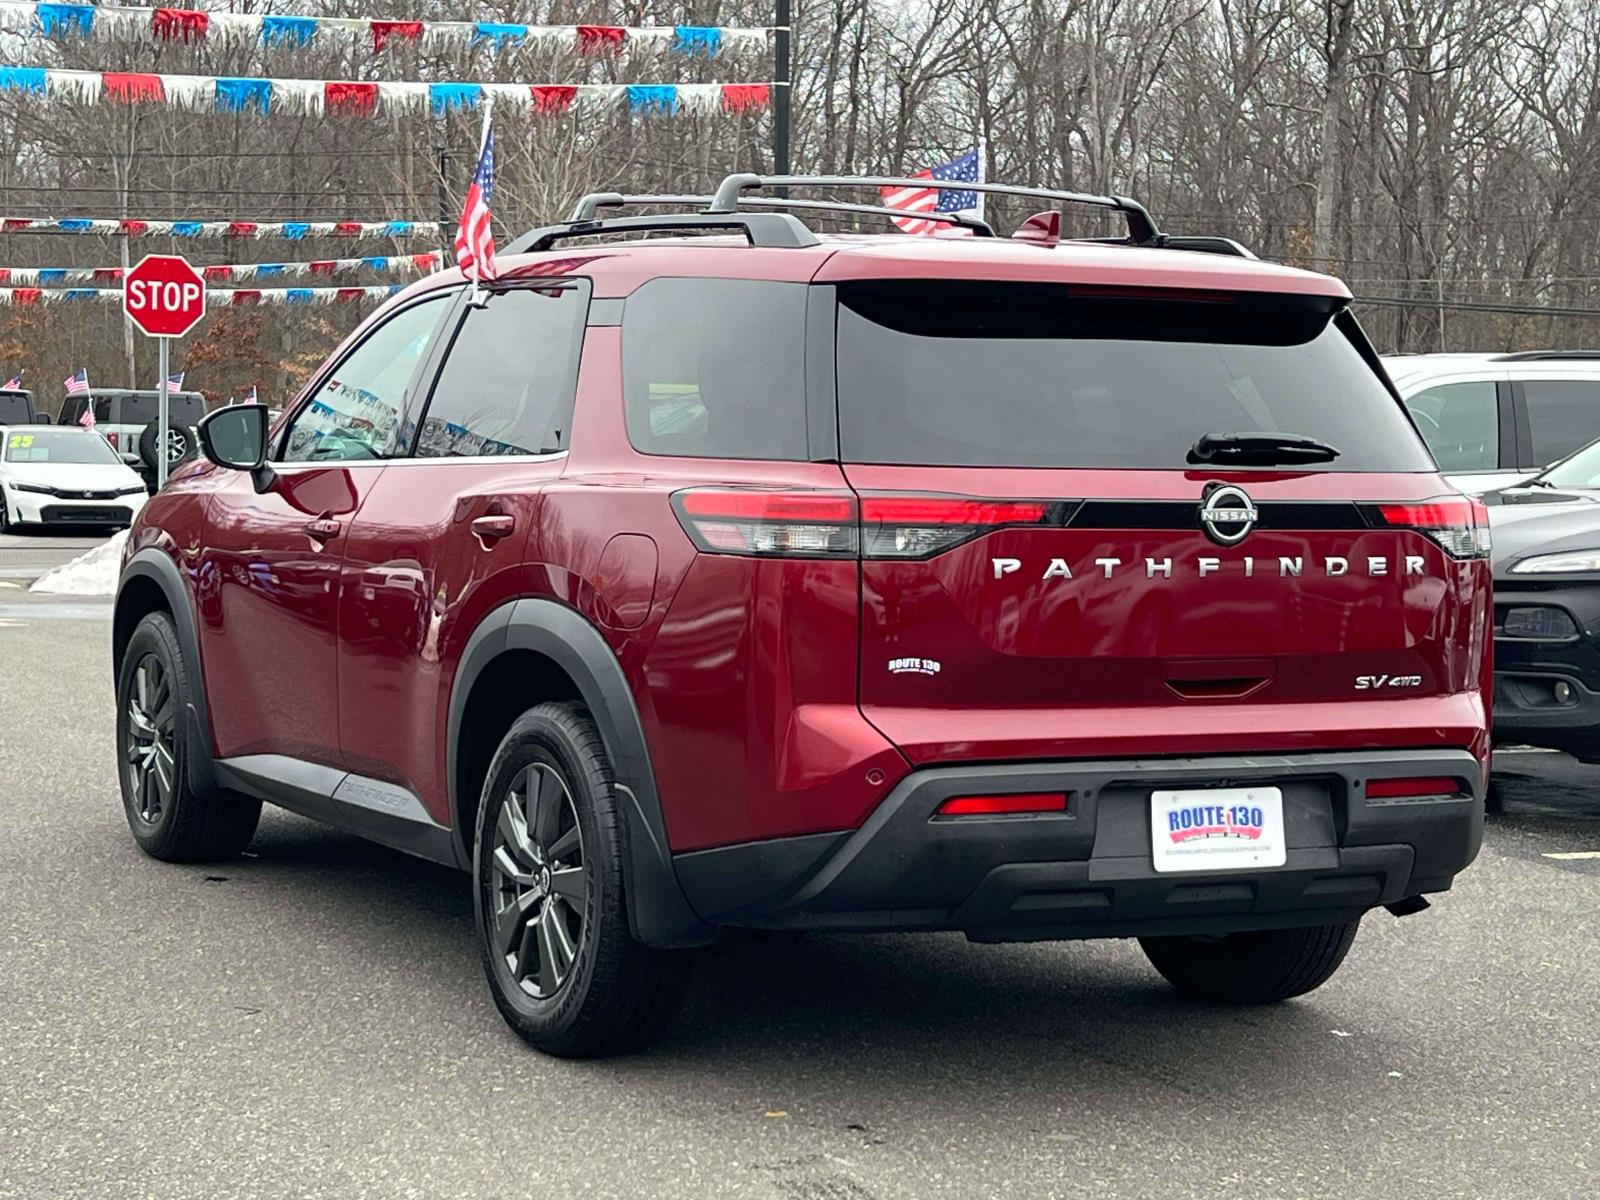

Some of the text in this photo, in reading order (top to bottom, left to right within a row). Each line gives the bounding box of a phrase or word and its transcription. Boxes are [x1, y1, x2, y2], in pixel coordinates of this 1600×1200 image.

[129, 279, 200, 312] STOP
[8, 434, 34, 448] 25
[1203, 511, 1258, 521] NISSAN
[992, 556, 1427, 580] PATHFINDER
[888, 658, 941, 672] ROUTE 130
[1354, 674, 1422, 689] SV 4WD
[1168, 806, 1263, 831] ROUTE 130
